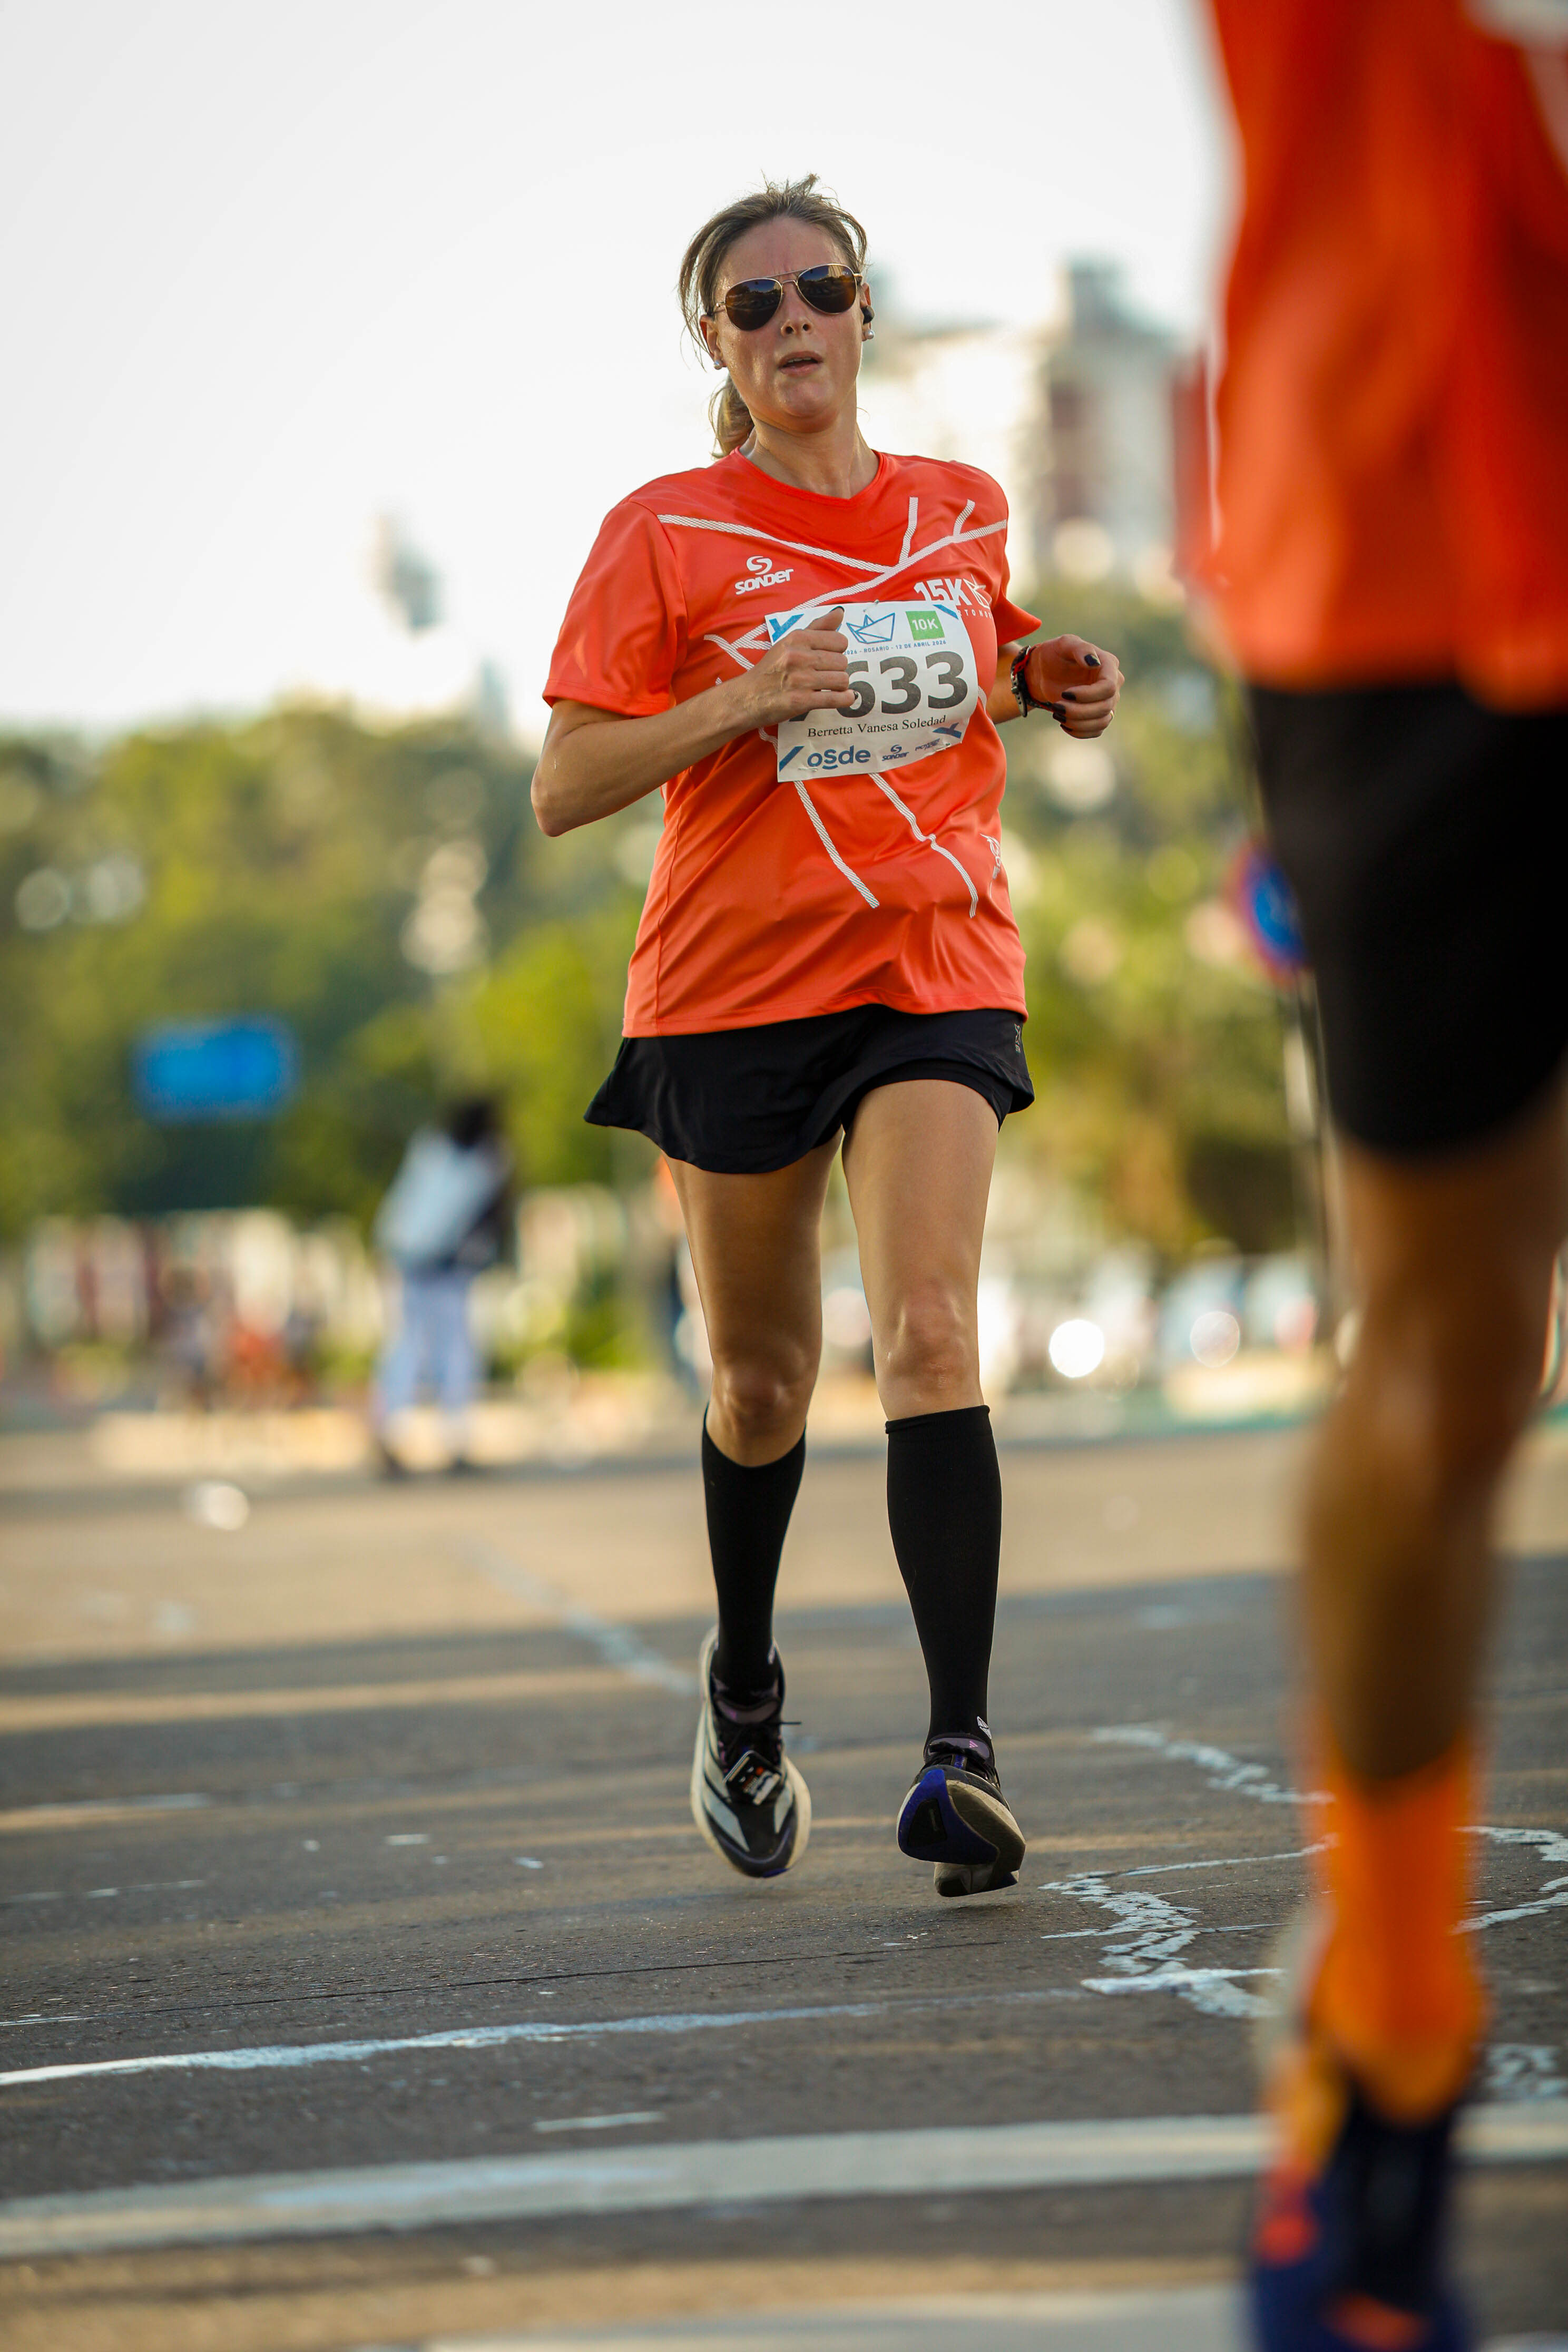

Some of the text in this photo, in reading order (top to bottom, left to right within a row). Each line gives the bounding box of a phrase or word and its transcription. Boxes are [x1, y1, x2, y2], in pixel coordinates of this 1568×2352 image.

[912, 619, 938, 631] 10K
[789, 651, 968, 722] 633
[808, 714, 946, 737] Berretta Vanesa Soledad
[807, 744, 871, 769] osde
